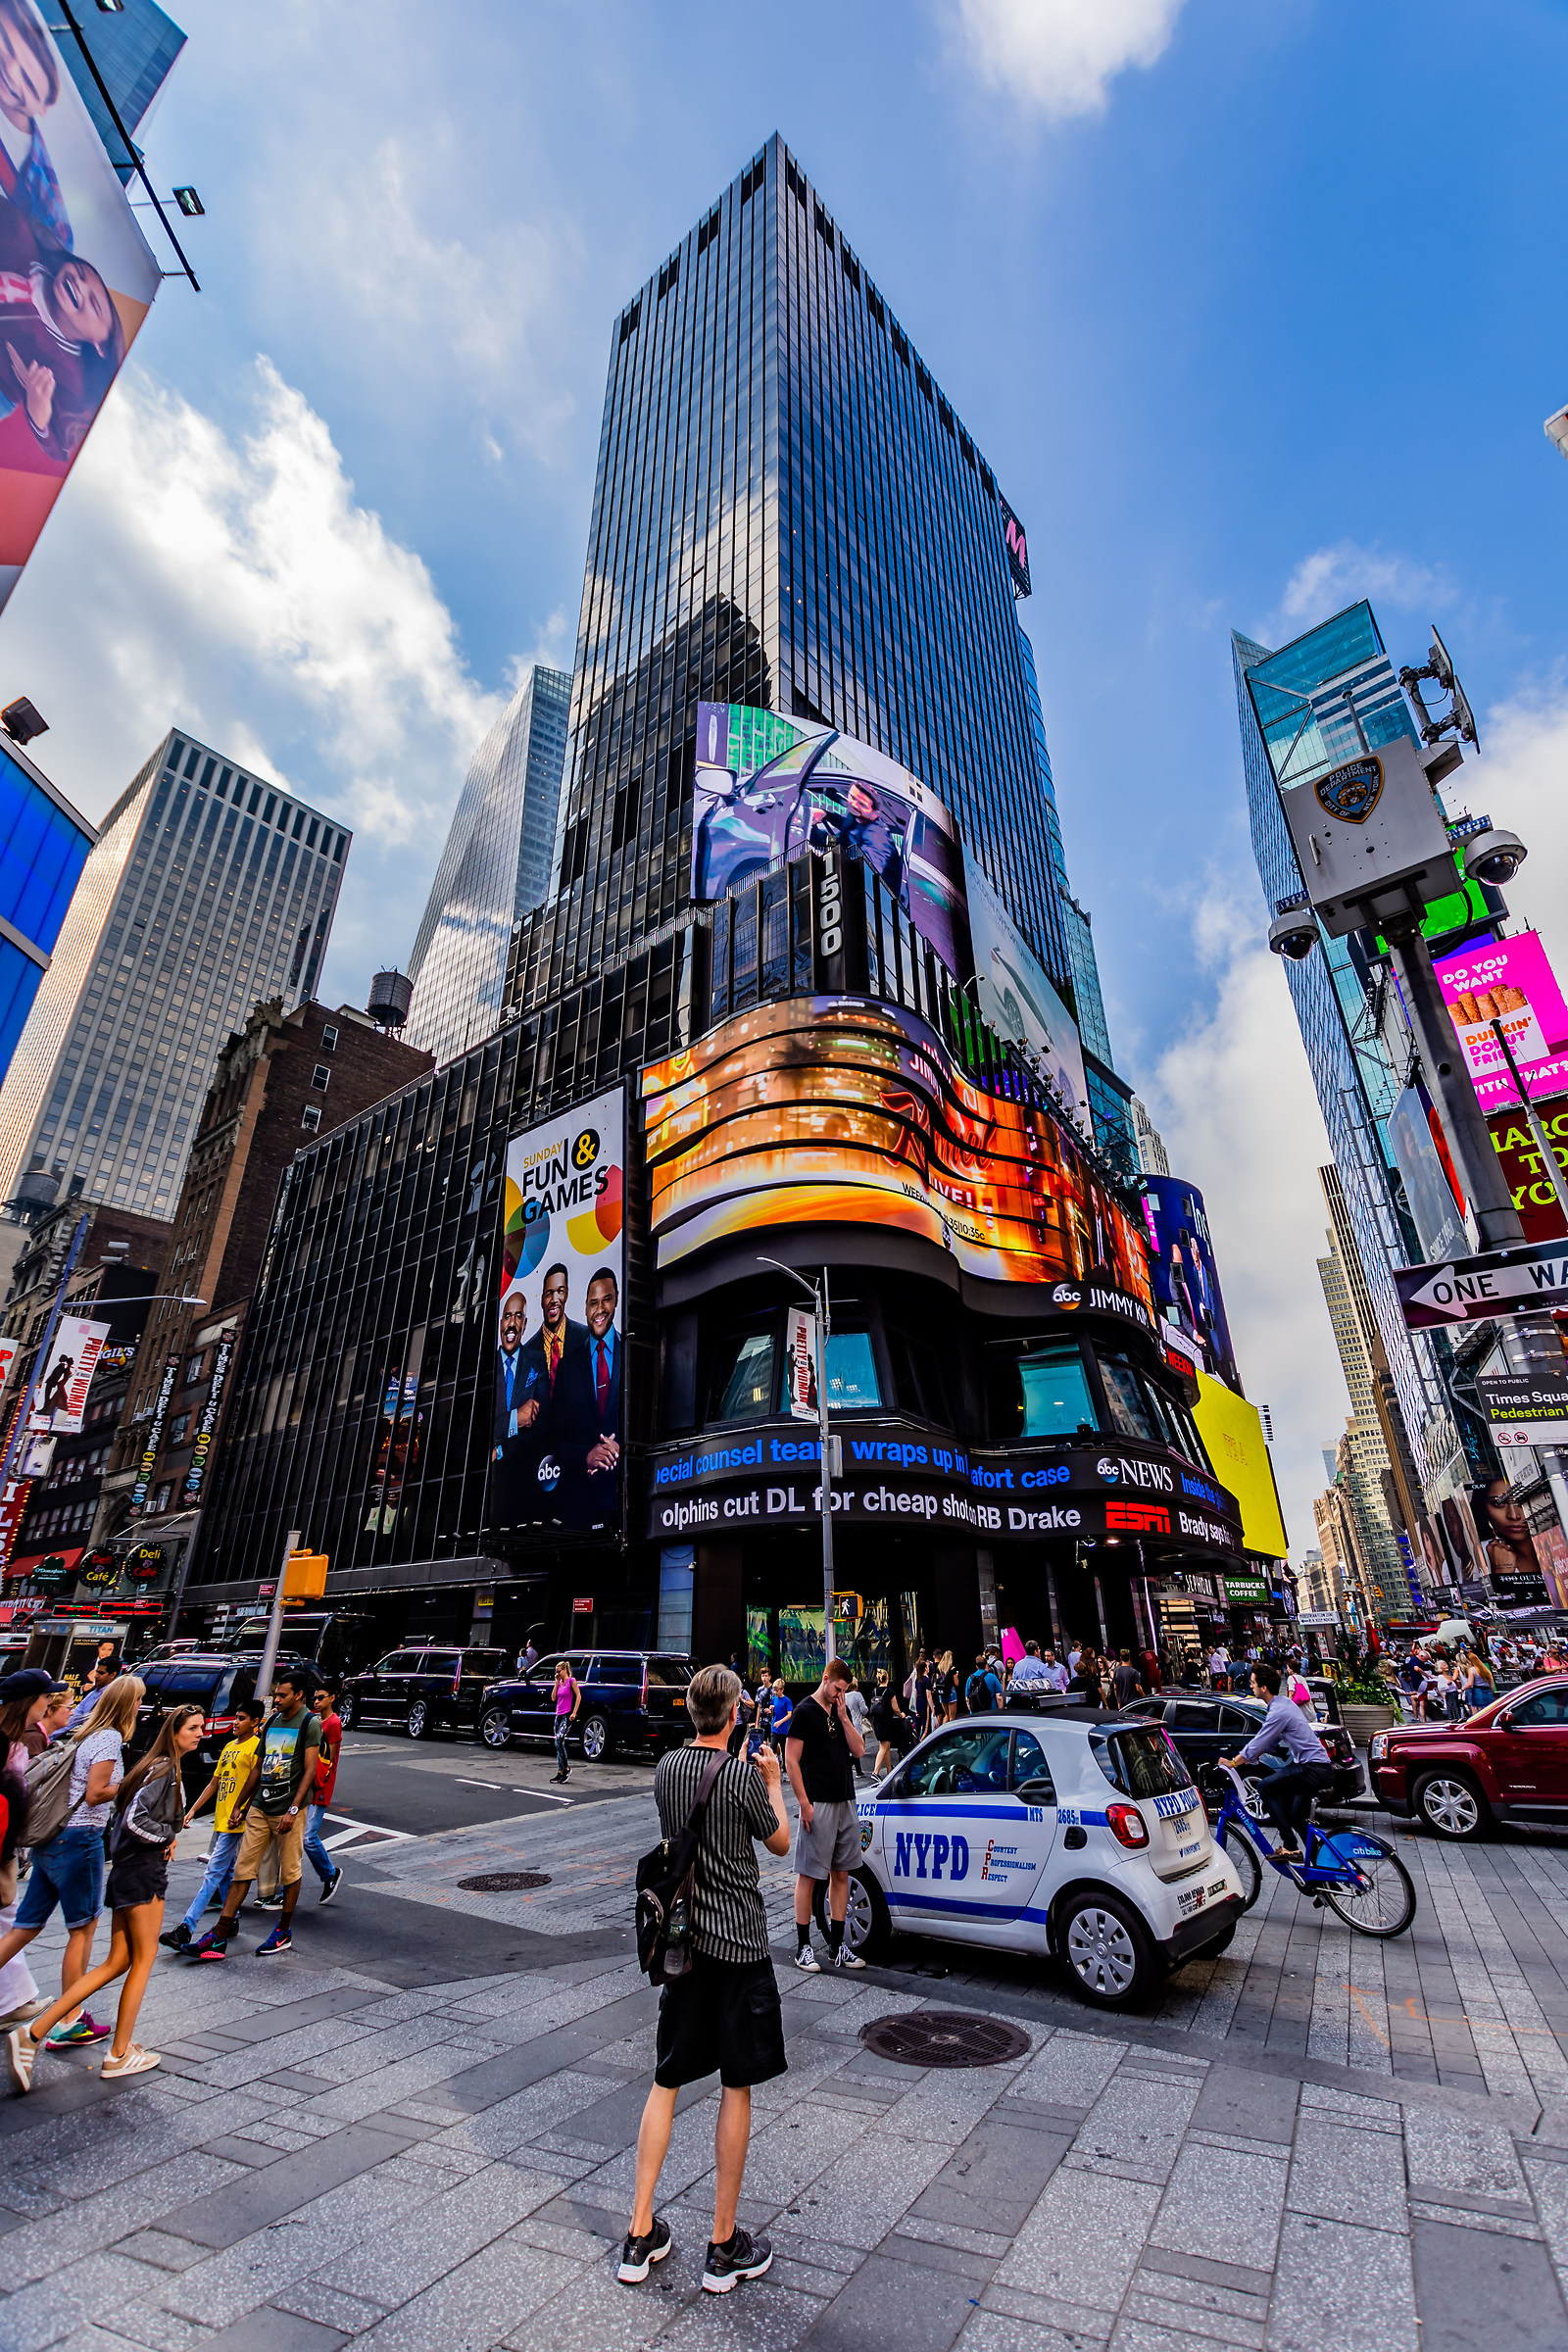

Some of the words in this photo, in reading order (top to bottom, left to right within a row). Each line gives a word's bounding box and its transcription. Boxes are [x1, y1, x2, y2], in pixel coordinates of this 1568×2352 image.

[1320, 765, 1377, 796] DEPARTMENT
[1329, 762, 1363, 782] POLICE
[1324, 800, 1340, 812] CITY
[1363, 795, 1375, 811] NEW
[1446, 815, 1489, 841] NYPD
[819, 852, 844, 957] 1500
[1275, 890, 1308, 911] NYPD
[1442, 969, 1468, 984] DO
[1472, 955, 1508, 973] YOU
[1452, 968, 1503, 992] WANT
[522, 1137, 568, 1197] FUN
[576, 1134, 596, 1165] &
[523, 1141, 563, 1168] SUNDAY
[520, 1165, 609, 1224] GAMES
[1510, 1181, 1558, 1210] YO
[1433, 1274, 1499, 1305] ONE
[1053, 1290, 1082, 1302] abc
[1090, 1288, 1133, 1318] JIMMY
[99, 1347, 135, 1361] GIL'S
[797, 1325, 808, 1361] PRETTY
[77, 1337, 103, 1374] PRETTY
[215, 1343, 231, 1374] TIMES
[161, 1366, 176, 1395] TIMES
[211, 1374, 224, 1399] DELI
[798, 1366, 809, 1403] WOMAN
[68, 1378, 89, 1417] WOMAN
[156, 1396, 169, 1419] DELI
[1485, 1394, 1531, 1405] Times
[1532, 1391, 1568, 1404] Squa
[201, 1407, 217, 1434] CAFE
[1490, 1406, 1565, 1420] Pedestrian
[146, 1427, 162, 1451] CAFE
[537, 1463, 561, 1482] abc
[696, 1439, 763, 1474] counsel
[852, 1441, 929, 1468] wraps
[932, 1447, 954, 1474] up
[955, 1447, 965, 1474] in
[969, 1465, 1015, 1489] afort
[1020, 1465, 1071, 1488] case
[1097, 1463, 1119, 1476] abc
[1117, 1458, 1174, 1492] NEWS
[1180, 1472, 1206, 1500] Inside
[661, 1497, 719, 1531] olphins
[723, 1490, 760, 1518] cut
[766, 1487, 806, 1513] DL
[812, 1486, 856, 1512] for
[862, 1486, 938, 1520] cheap
[942, 1493, 969, 1522] shot
[976, 1504, 1002, 1529] RB
[1007, 1505, 1081, 1530] Drake
[1105, 1500, 1171, 1534] ESPN
[1178, 1510, 1209, 1543] Brady
[1208, 1523, 1225, 1545] says
[92, 1554, 113, 1564] Deli
[139, 1548, 161, 1559] Deli
[86, 1571, 110, 1582] Café
[132, 1567, 158, 1578] Café
[1185, 1574, 1214, 1597] SEPHORA
[1224, 1581, 1266, 1590] TARBUCKS
[221, 1750, 241, 1762] BEST
[856, 1804, 876, 1817] LICE
[1152, 1794, 1182, 1818] NYPD
[1236, 1808, 1247, 1820] citi
[1243, 1818, 1256, 1836] bike
[894, 1832, 970, 1882] NYPD
[987, 1839, 1018, 1855] COURTESY
[1365, 1847, 1382, 1856] bike
[985, 1853, 1037, 1871] PROFESSIONALISM
[981, 1867, 1008, 1883] RESPECT
